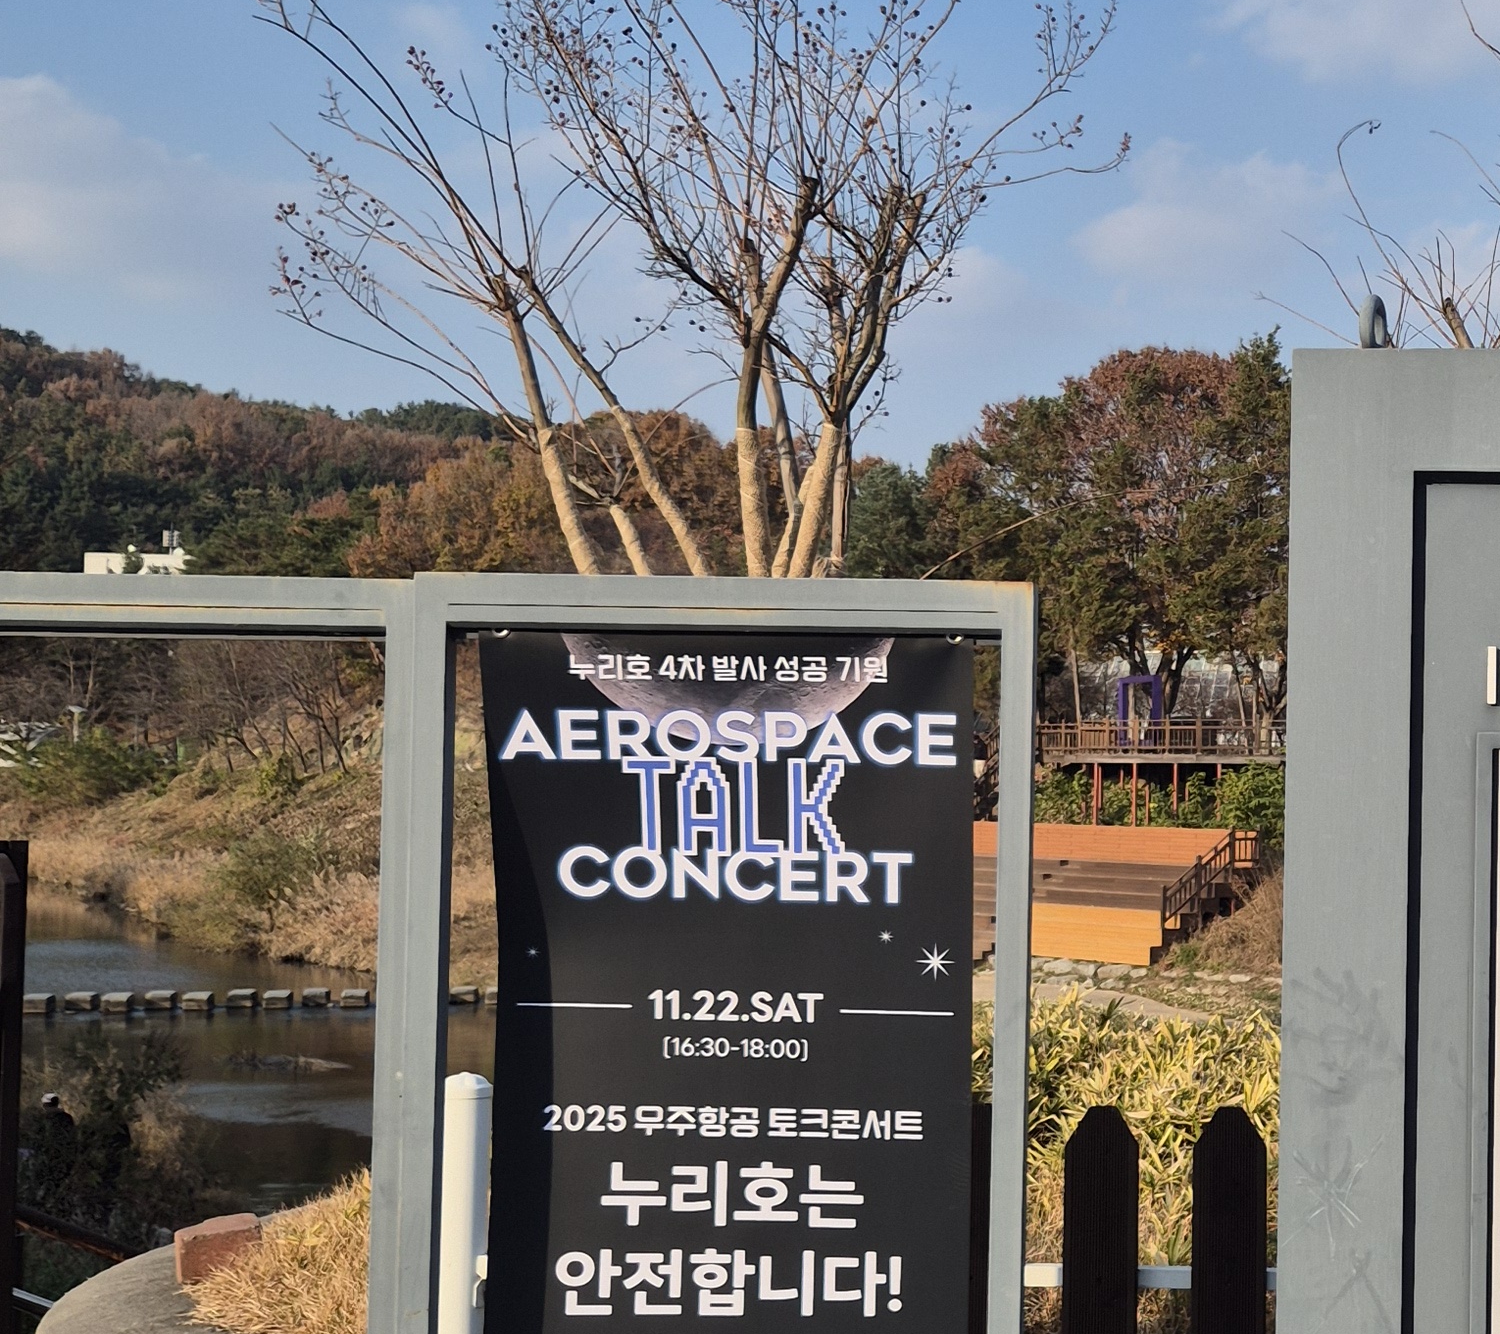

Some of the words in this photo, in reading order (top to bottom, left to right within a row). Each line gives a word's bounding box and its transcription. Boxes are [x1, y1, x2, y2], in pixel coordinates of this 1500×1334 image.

[568, 654, 653, 682] 누리호
[659, 654, 705, 682] 4차
[711, 656, 767, 683] 발사
[774, 656, 827, 683] 성공
[836, 654, 888, 684] 기원
[499, 708, 958, 767] AEROSPACE
[621, 756, 846, 857] TALK
[558, 845, 913, 904] CONCERT
[647, 988, 824, 1024] 11.22.SAT
[543, 1104, 627, 1133] 2025
[633, 1105, 761, 1138] 우주항공
[767, 1108, 923, 1141] 토크콘서트
[600, 1159, 865, 1229] 누리호는
[554, 1247, 903, 1318] 안전합니다!
